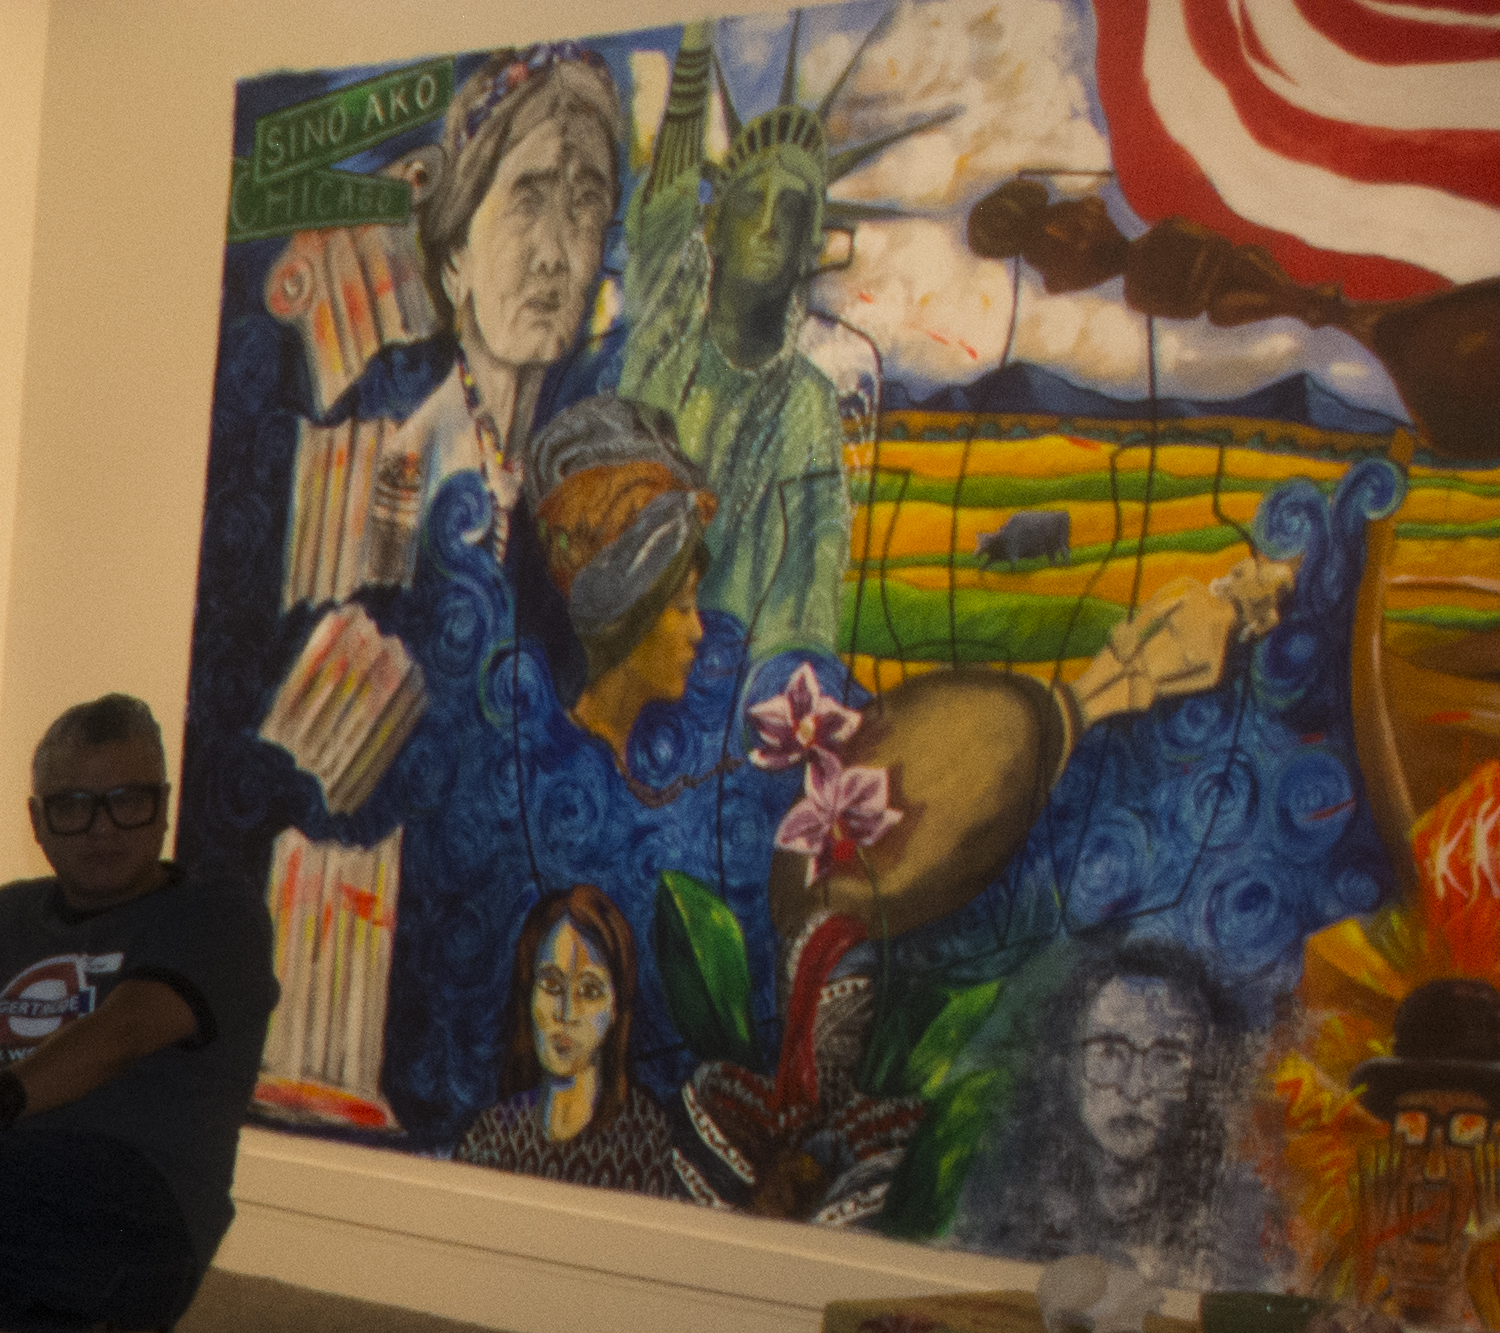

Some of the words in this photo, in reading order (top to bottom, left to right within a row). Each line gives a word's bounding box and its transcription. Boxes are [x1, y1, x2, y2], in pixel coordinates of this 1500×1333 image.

[265, 104, 347, 167] SINO
[362, 73, 436, 133] AKO
[231, 171, 393, 231] CHICAGO
